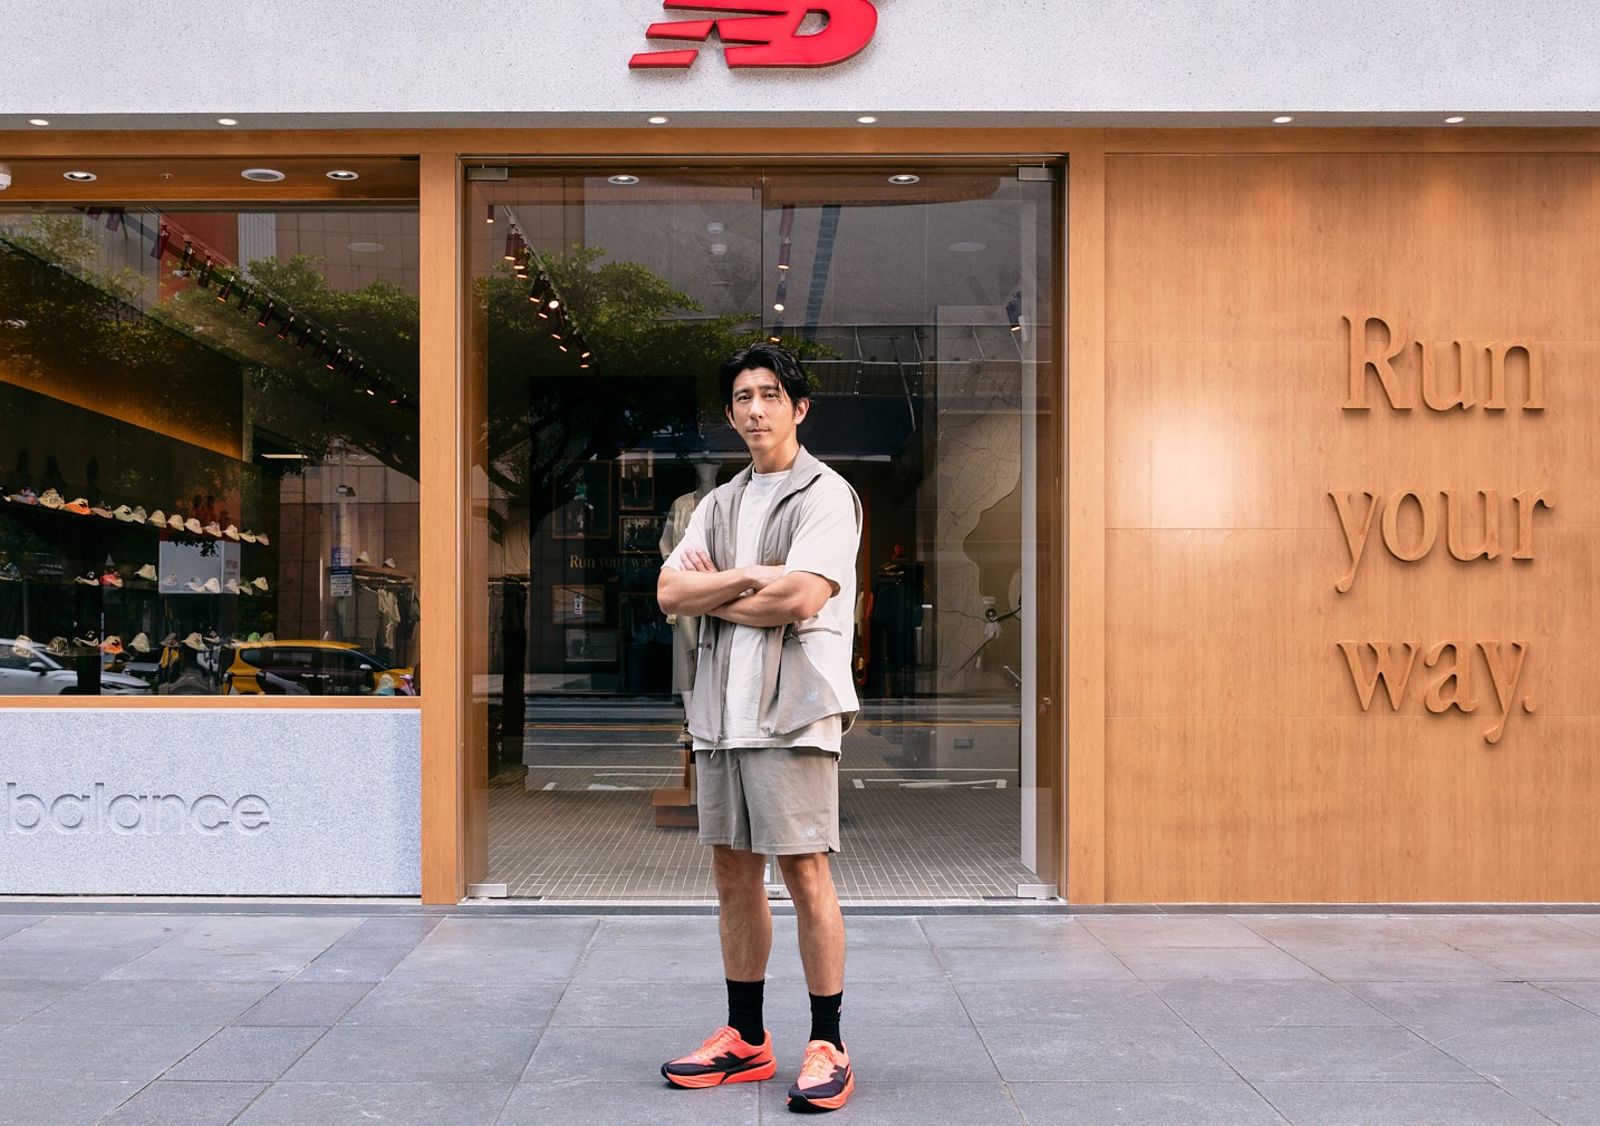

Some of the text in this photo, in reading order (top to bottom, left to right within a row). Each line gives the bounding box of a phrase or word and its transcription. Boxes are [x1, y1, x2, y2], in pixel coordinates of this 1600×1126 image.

[1342, 311, 1545, 411] Run
[569, 554, 595, 568] Run
[1327, 489, 1554, 593] your
[1336, 640, 1536, 745] way.
[6, 782, 271, 836] balance
